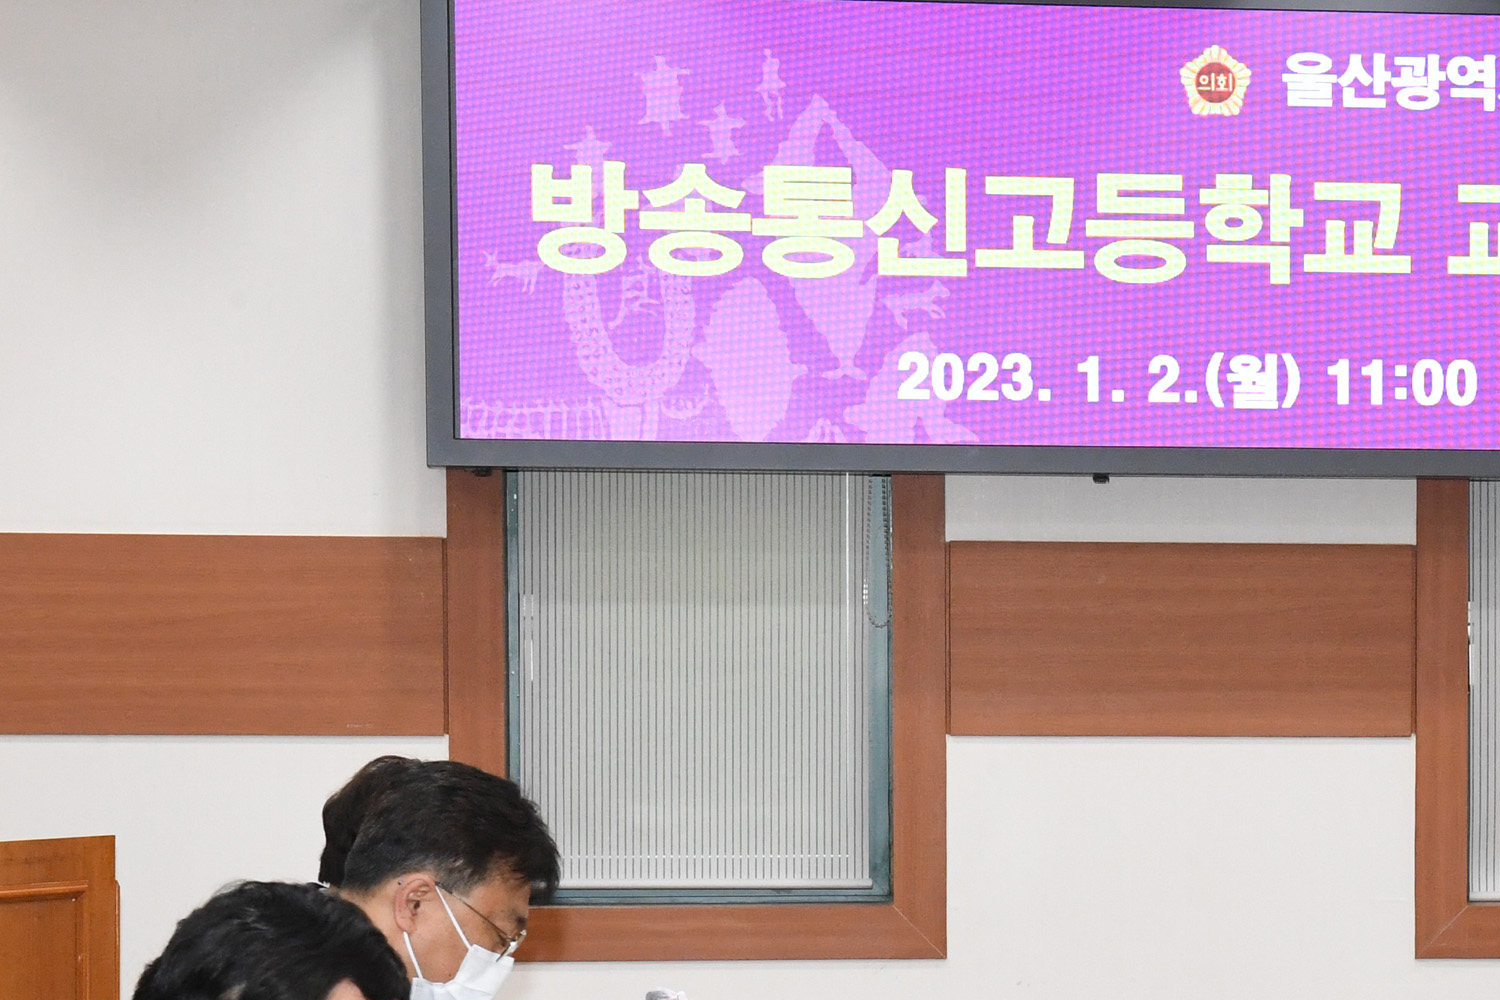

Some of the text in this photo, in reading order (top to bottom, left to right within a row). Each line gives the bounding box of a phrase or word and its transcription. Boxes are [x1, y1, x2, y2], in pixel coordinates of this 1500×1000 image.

[1198, 72, 1233, 92] 의회
[530, 161, 1412, 286] 방송통신고등학교
[897, 352, 1478, 410] 2023. 1. 2.(월) 11:00
